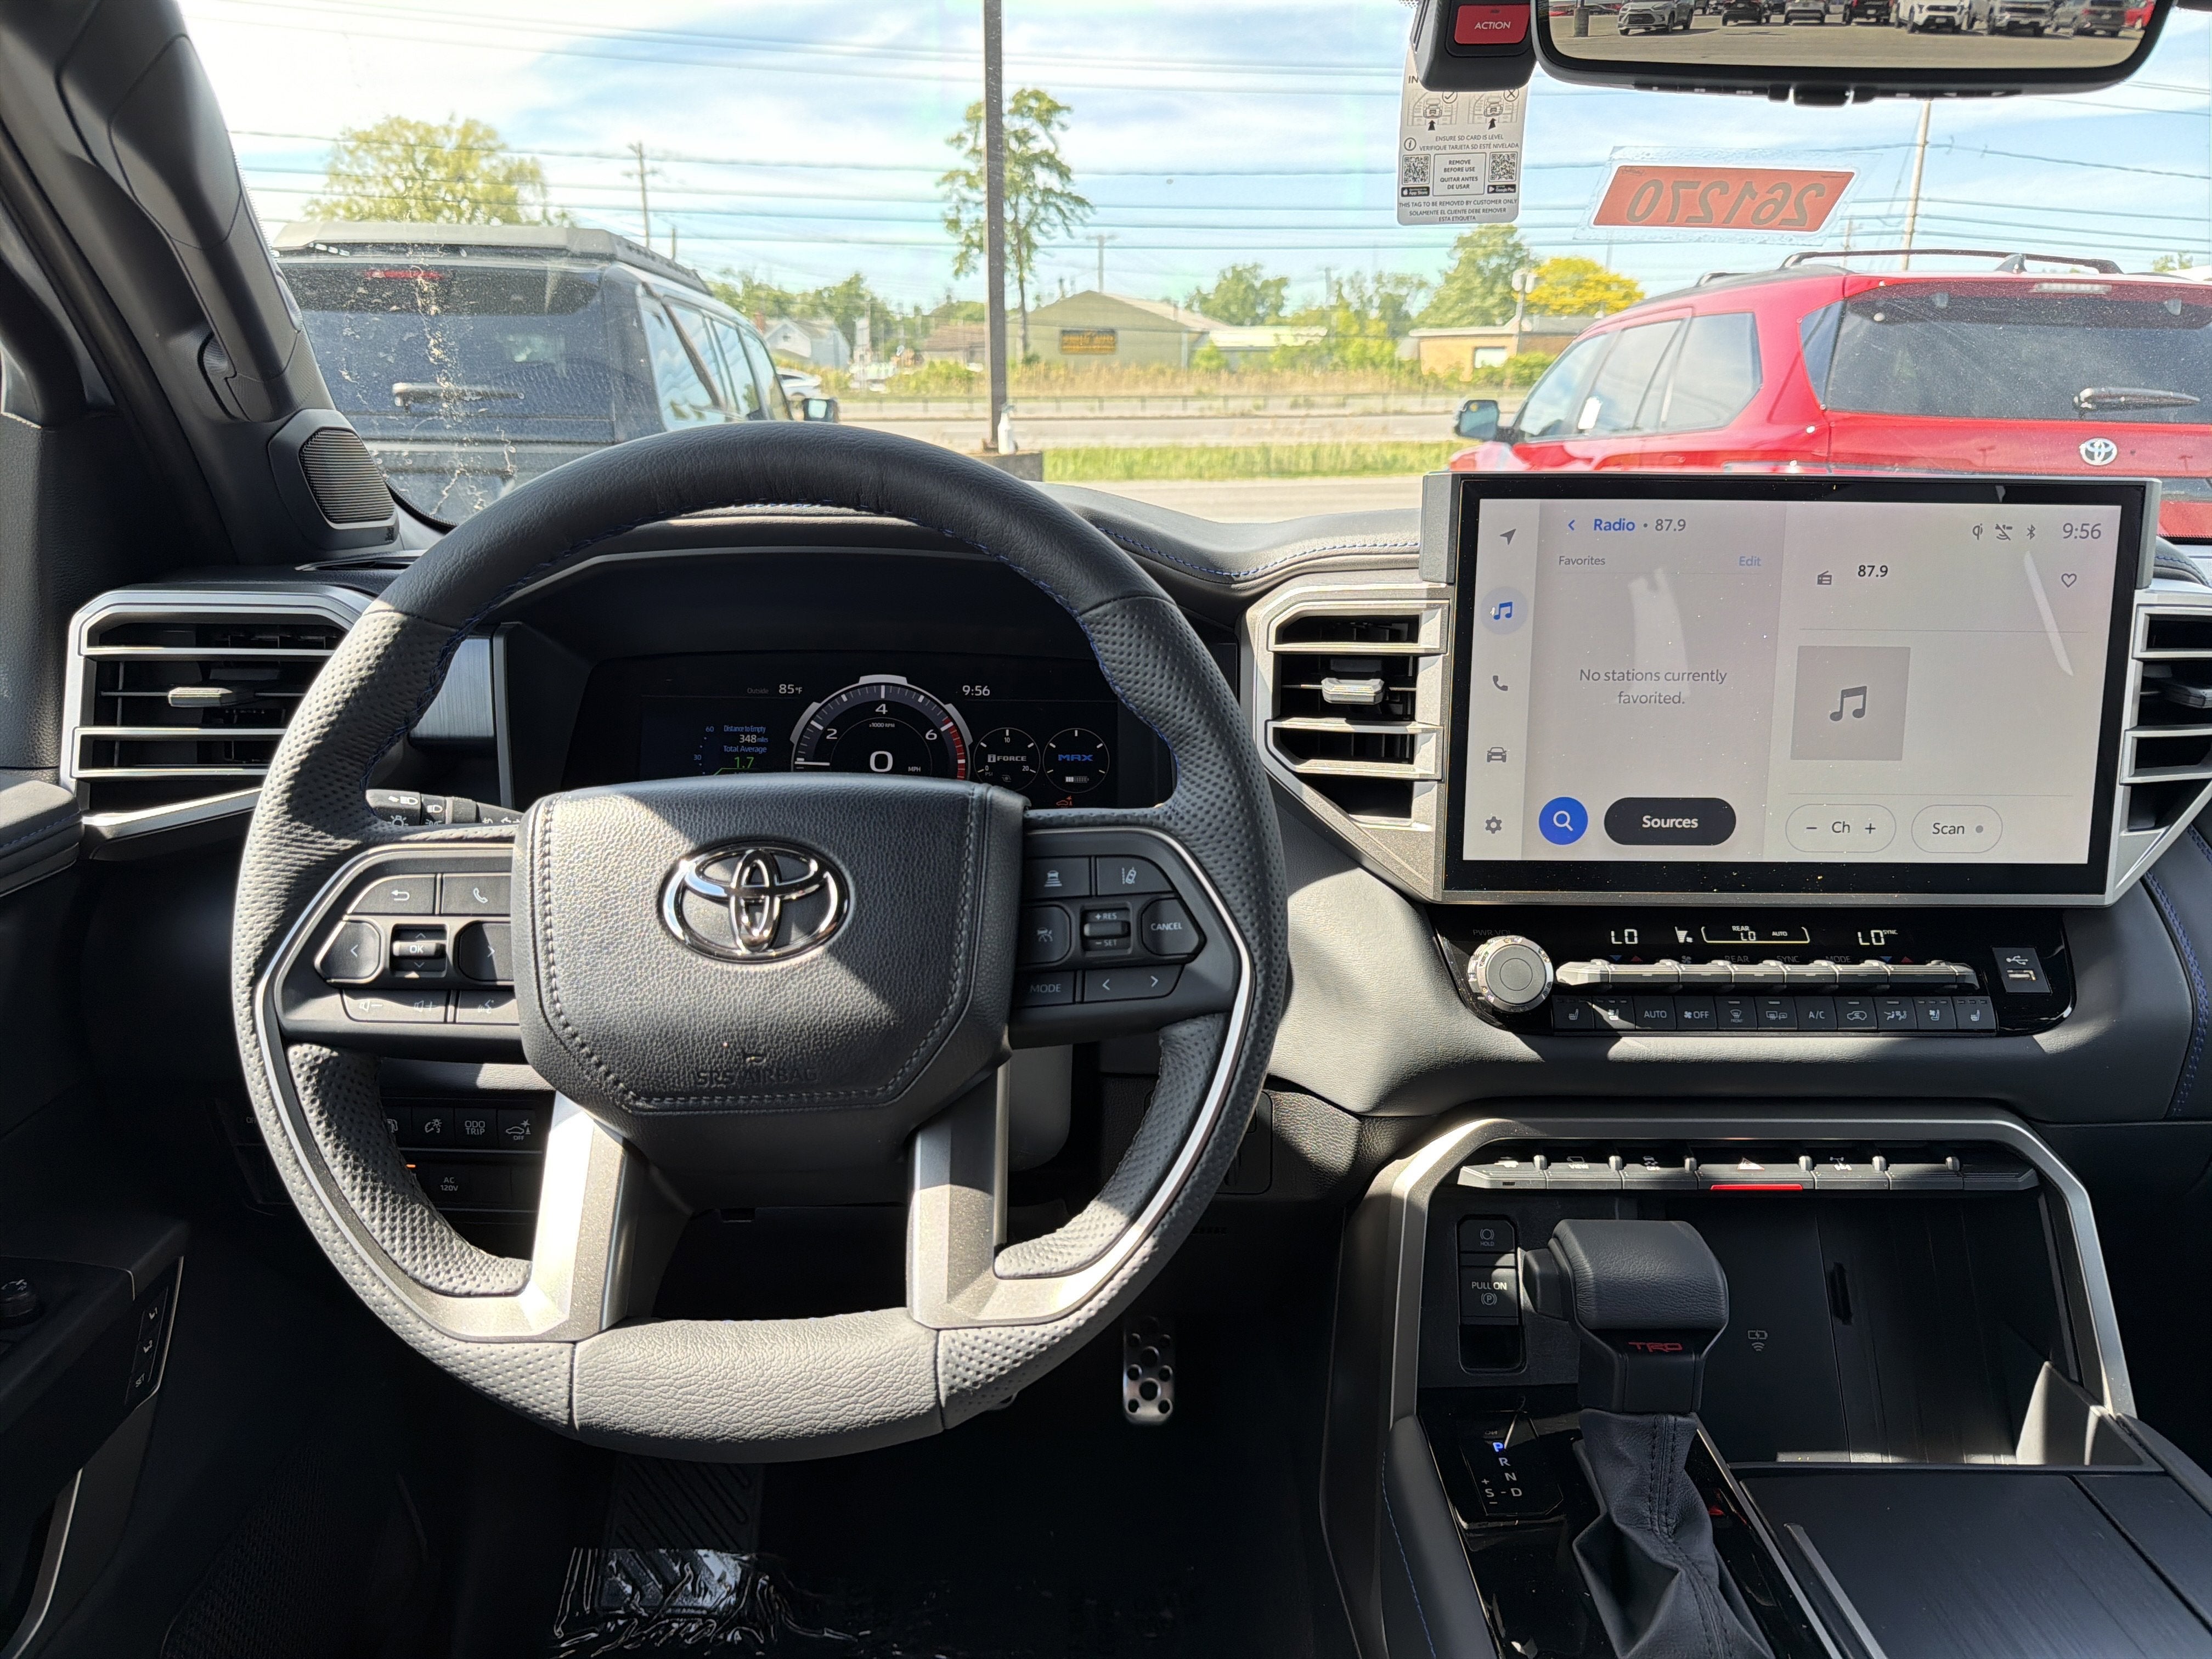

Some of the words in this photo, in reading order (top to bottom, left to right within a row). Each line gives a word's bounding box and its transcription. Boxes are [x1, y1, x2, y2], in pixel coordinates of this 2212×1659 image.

[1474, 21, 1511, 30] ACTION
[1593, 518, 1635, 531] Radio
[1655, 519, 1686, 532] 87.9
[2063, 522, 2102, 539] 9:56
[1558, 556, 1606, 566] Favorites
[1739, 556, 1762, 567] Edit
[1858, 565, 1888, 578] 87.9
[1579, 669, 1601, 681] No
[1603, 668, 1660, 681] stations
[1664, 669, 1727, 684] currently
[962, 685, 990, 696] 9:56
[1617, 691, 1685, 704] favorited.
[875, 703, 888, 714] 4
[750, 725, 766, 733] Empty
[826, 728, 838, 740] 2
[739, 734, 757, 743] 348
[925, 729, 938, 741] 6
[741, 745, 767, 754] Average
[870, 751, 893, 772] 0
[1642, 815, 1699, 828] Sources
[1831, 821, 1850, 833] Ch
[1932, 822, 1965, 835] Scan
[1150, 922, 1182, 931] CANCEL
[409, 945, 424, 953] OK
[1030, 984, 1062, 993] MODE
[1644, 1011, 1667, 1019] AUTO
[1693, 1011, 1709, 1019] OFF
[1808, 1011, 1825, 1019] A/C
[695, 1071, 736, 1088] SRS
[743, 1069, 820, 1085] AIRBAG
[1471, 1282, 1491, 1290] PULL
[1493, 1282, 1508, 1290] ON
[1628, 1342, 1683, 1352] TRD
[1492, 1442, 1504, 1452] P
[1498, 1457, 1511, 1466] R
[1504, 1472, 1517, 1481] N
[1485, 1488, 1495, 1498] S
[1510, 1488, 1522, 1497] D
